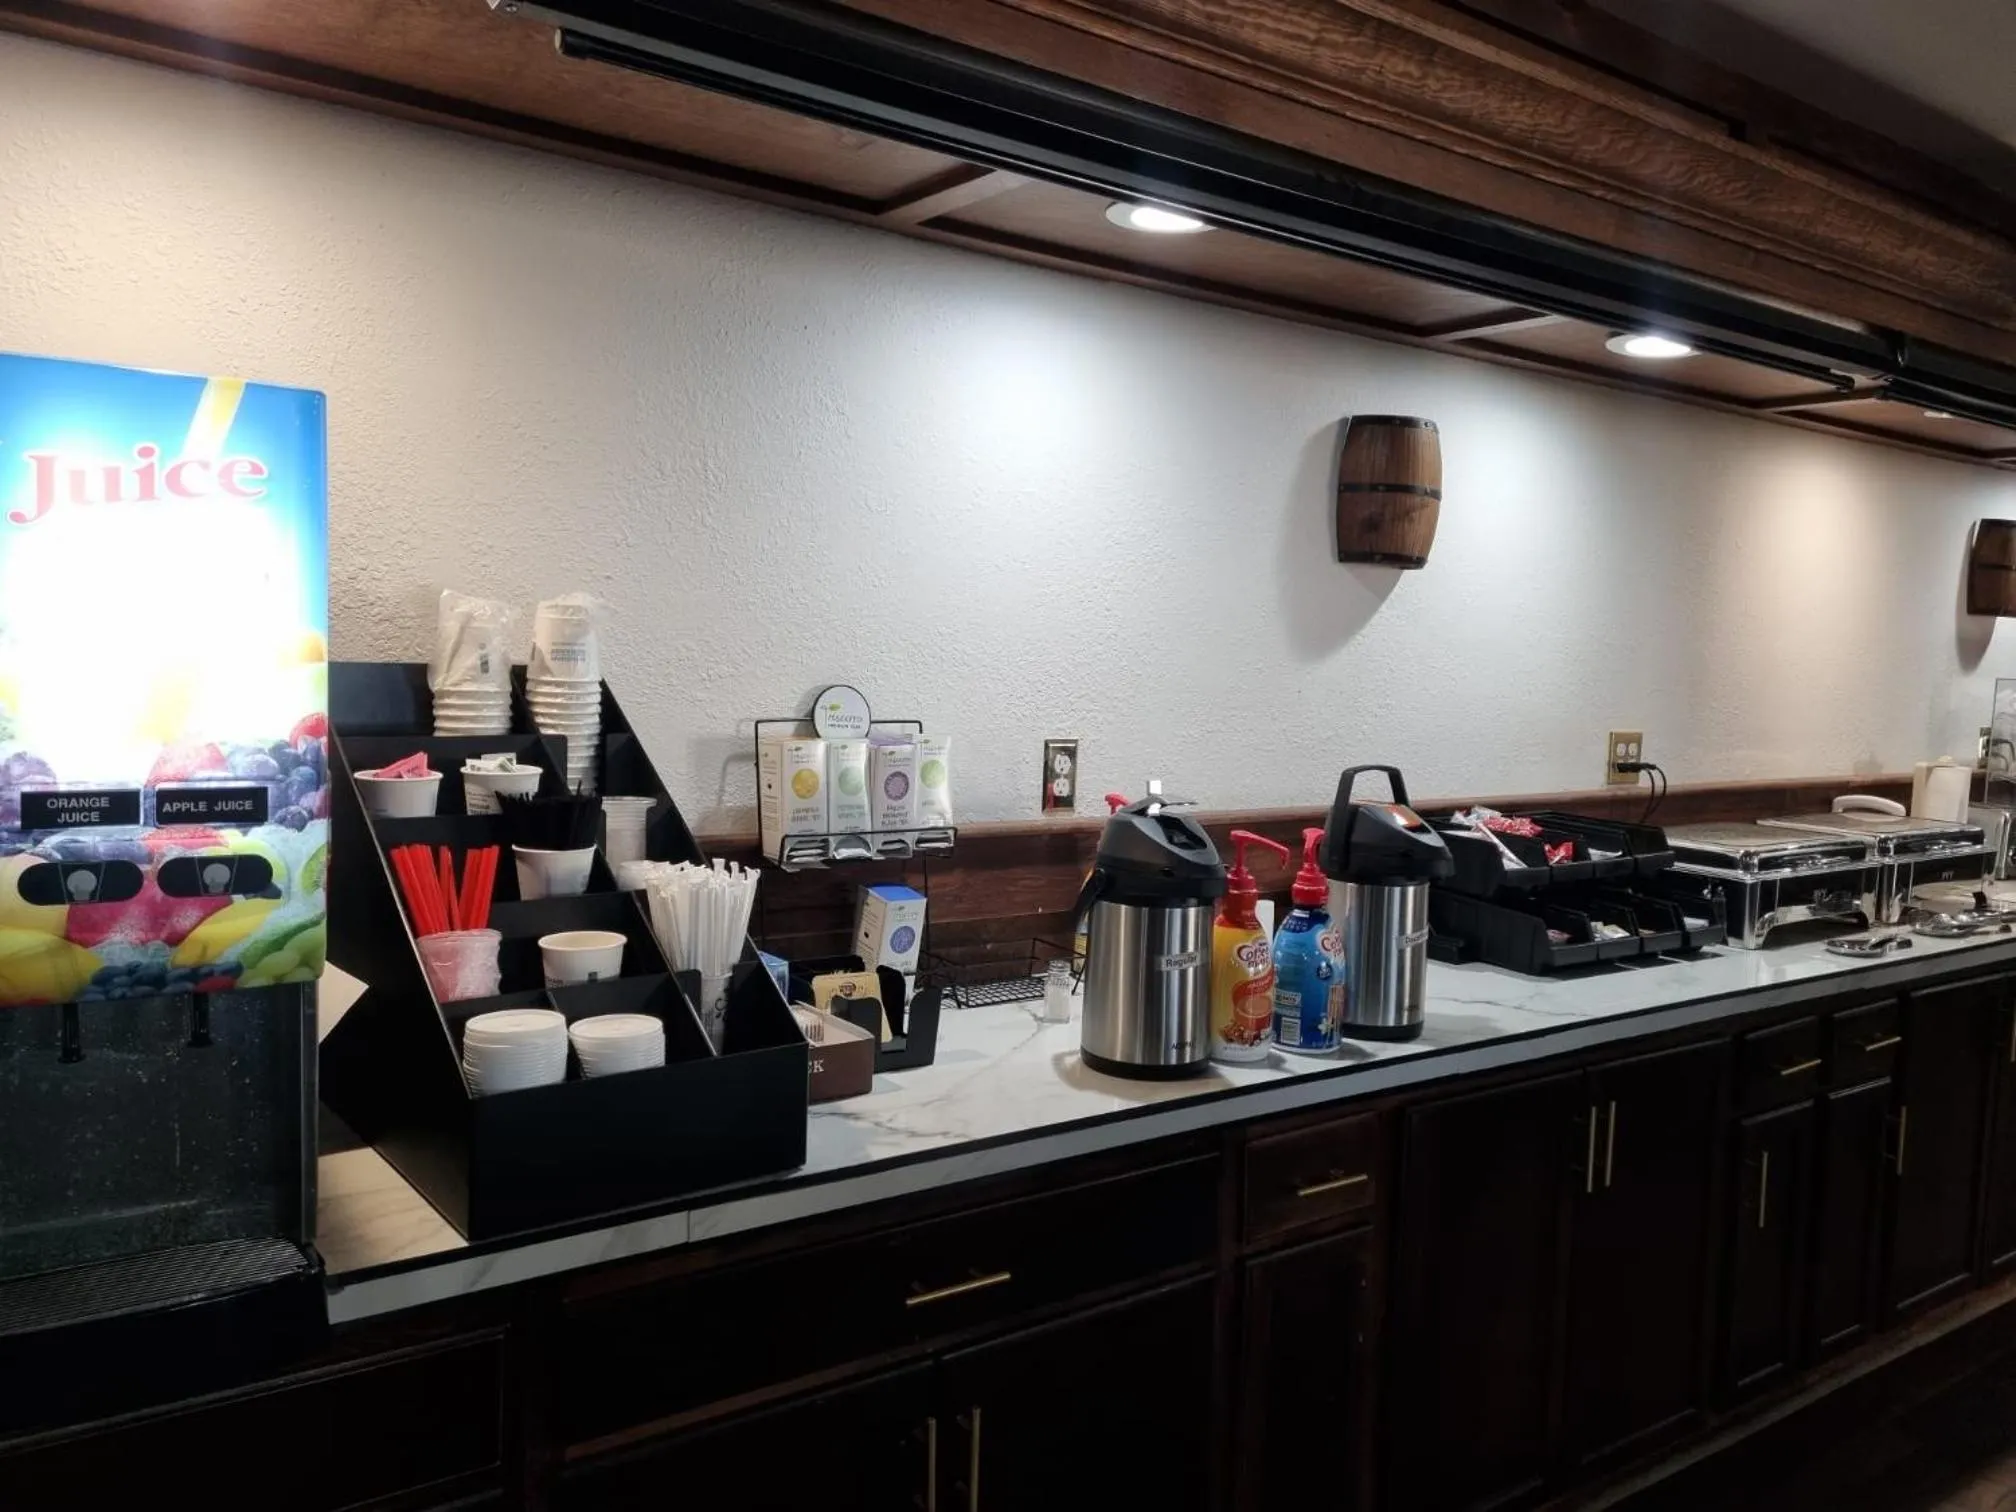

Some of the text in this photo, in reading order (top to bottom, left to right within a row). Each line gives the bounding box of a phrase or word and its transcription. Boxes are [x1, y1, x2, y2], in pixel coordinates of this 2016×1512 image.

[8, 445, 266, 524] Juice
[46, 796, 111, 810] ORANGE
[162, 799, 254, 813] APPLE JUICE
[57, 811, 101, 823] JUICE
[1166, 953, 1197, 968] Regular
